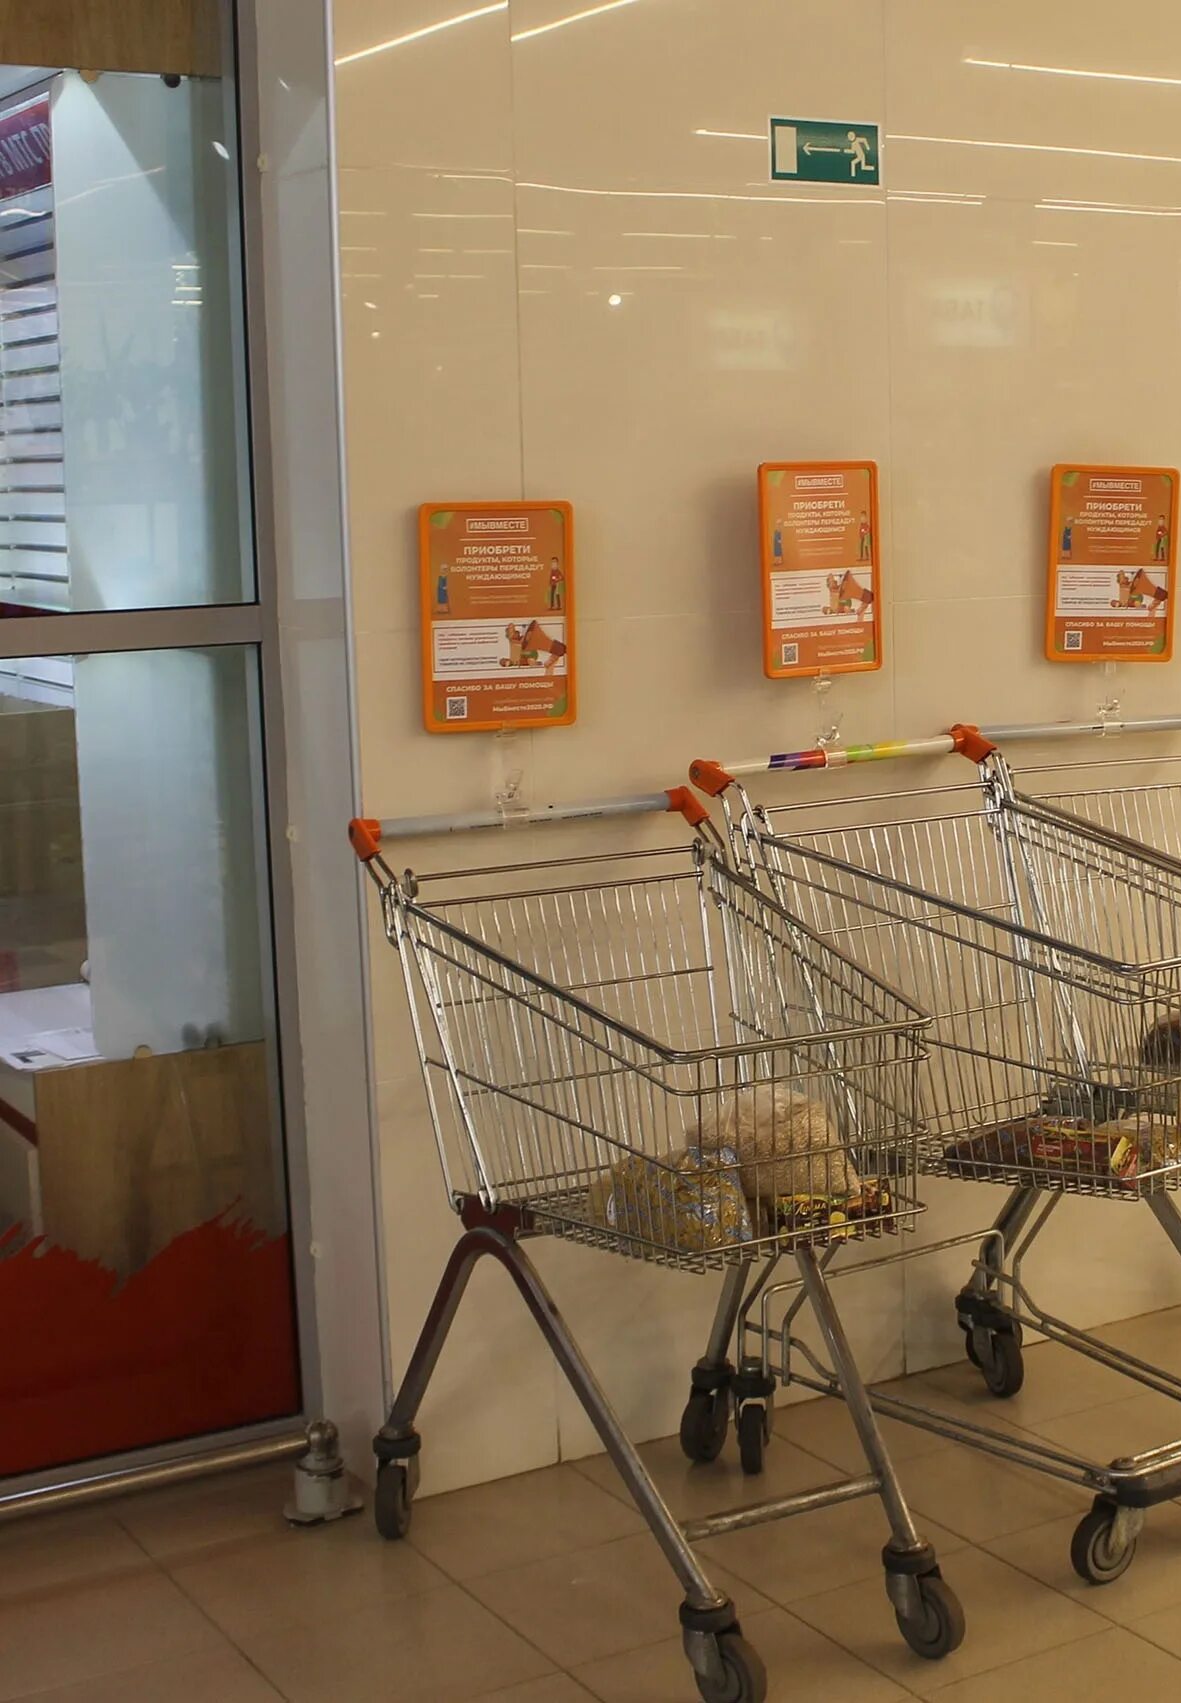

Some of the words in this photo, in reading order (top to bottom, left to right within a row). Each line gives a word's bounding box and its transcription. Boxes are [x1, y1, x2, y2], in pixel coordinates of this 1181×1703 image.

[793, 500, 845, 510] ПРИОБРЕТИ
[1086, 502, 1142, 511] ПРИОБРЕТИ
[463, 545, 531, 555] ПРИОБРЕТИ
